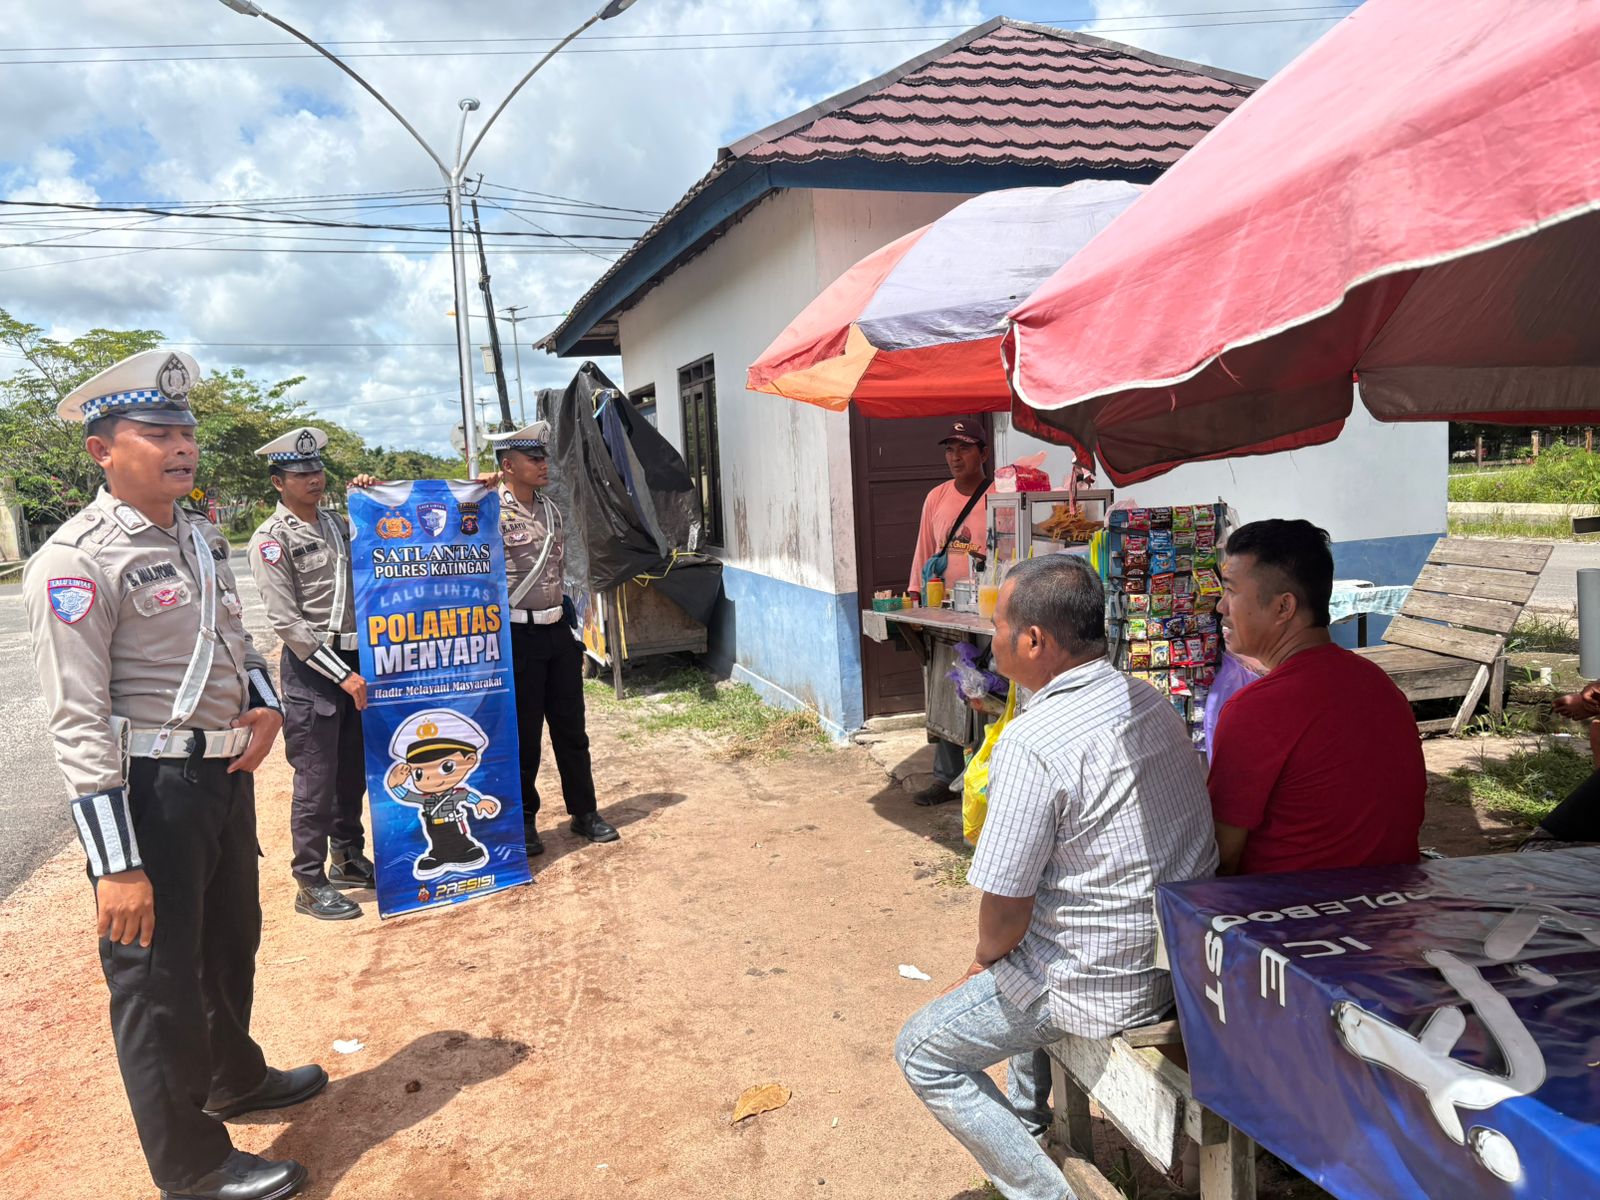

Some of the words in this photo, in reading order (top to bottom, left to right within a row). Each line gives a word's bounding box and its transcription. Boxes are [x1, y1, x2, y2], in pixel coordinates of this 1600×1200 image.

[373, 544, 490, 563] SATLANTAS
[375, 563, 427, 579] POLRES
[431, 560, 490, 576] KATINGAN
[380, 586, 425, 608] LALU
[434, 583, 490, 601] LINTAS
[368, 604, 501, 645] POLANTAS
[374, 633, 500, 676] MENYAPA
[374, 687, 404, 699] Hadir
[405, 682, 450, 697] Melayani
[451, 676, 503, 693] Masyarakat
[435, 874, 495, 897] PRESISI
